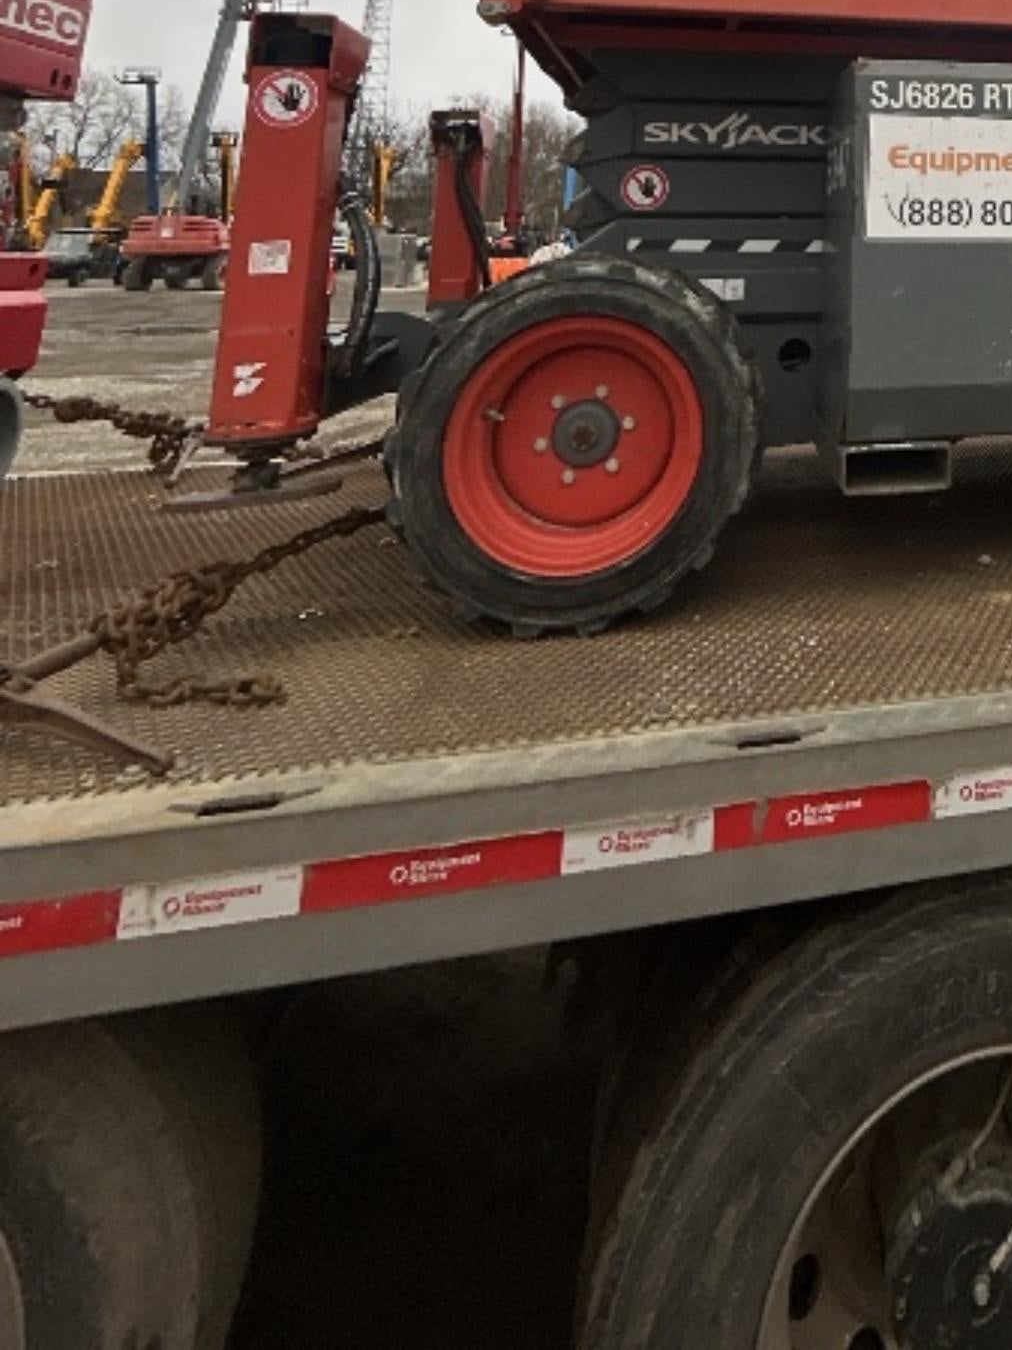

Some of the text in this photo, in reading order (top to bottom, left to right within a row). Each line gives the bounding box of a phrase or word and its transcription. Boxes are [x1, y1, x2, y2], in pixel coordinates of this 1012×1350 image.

[869, 80, 974, 110] SJ6826
[644, 110, 829, 148] SKYJACK
[899, 199, 973, 228] (888)
